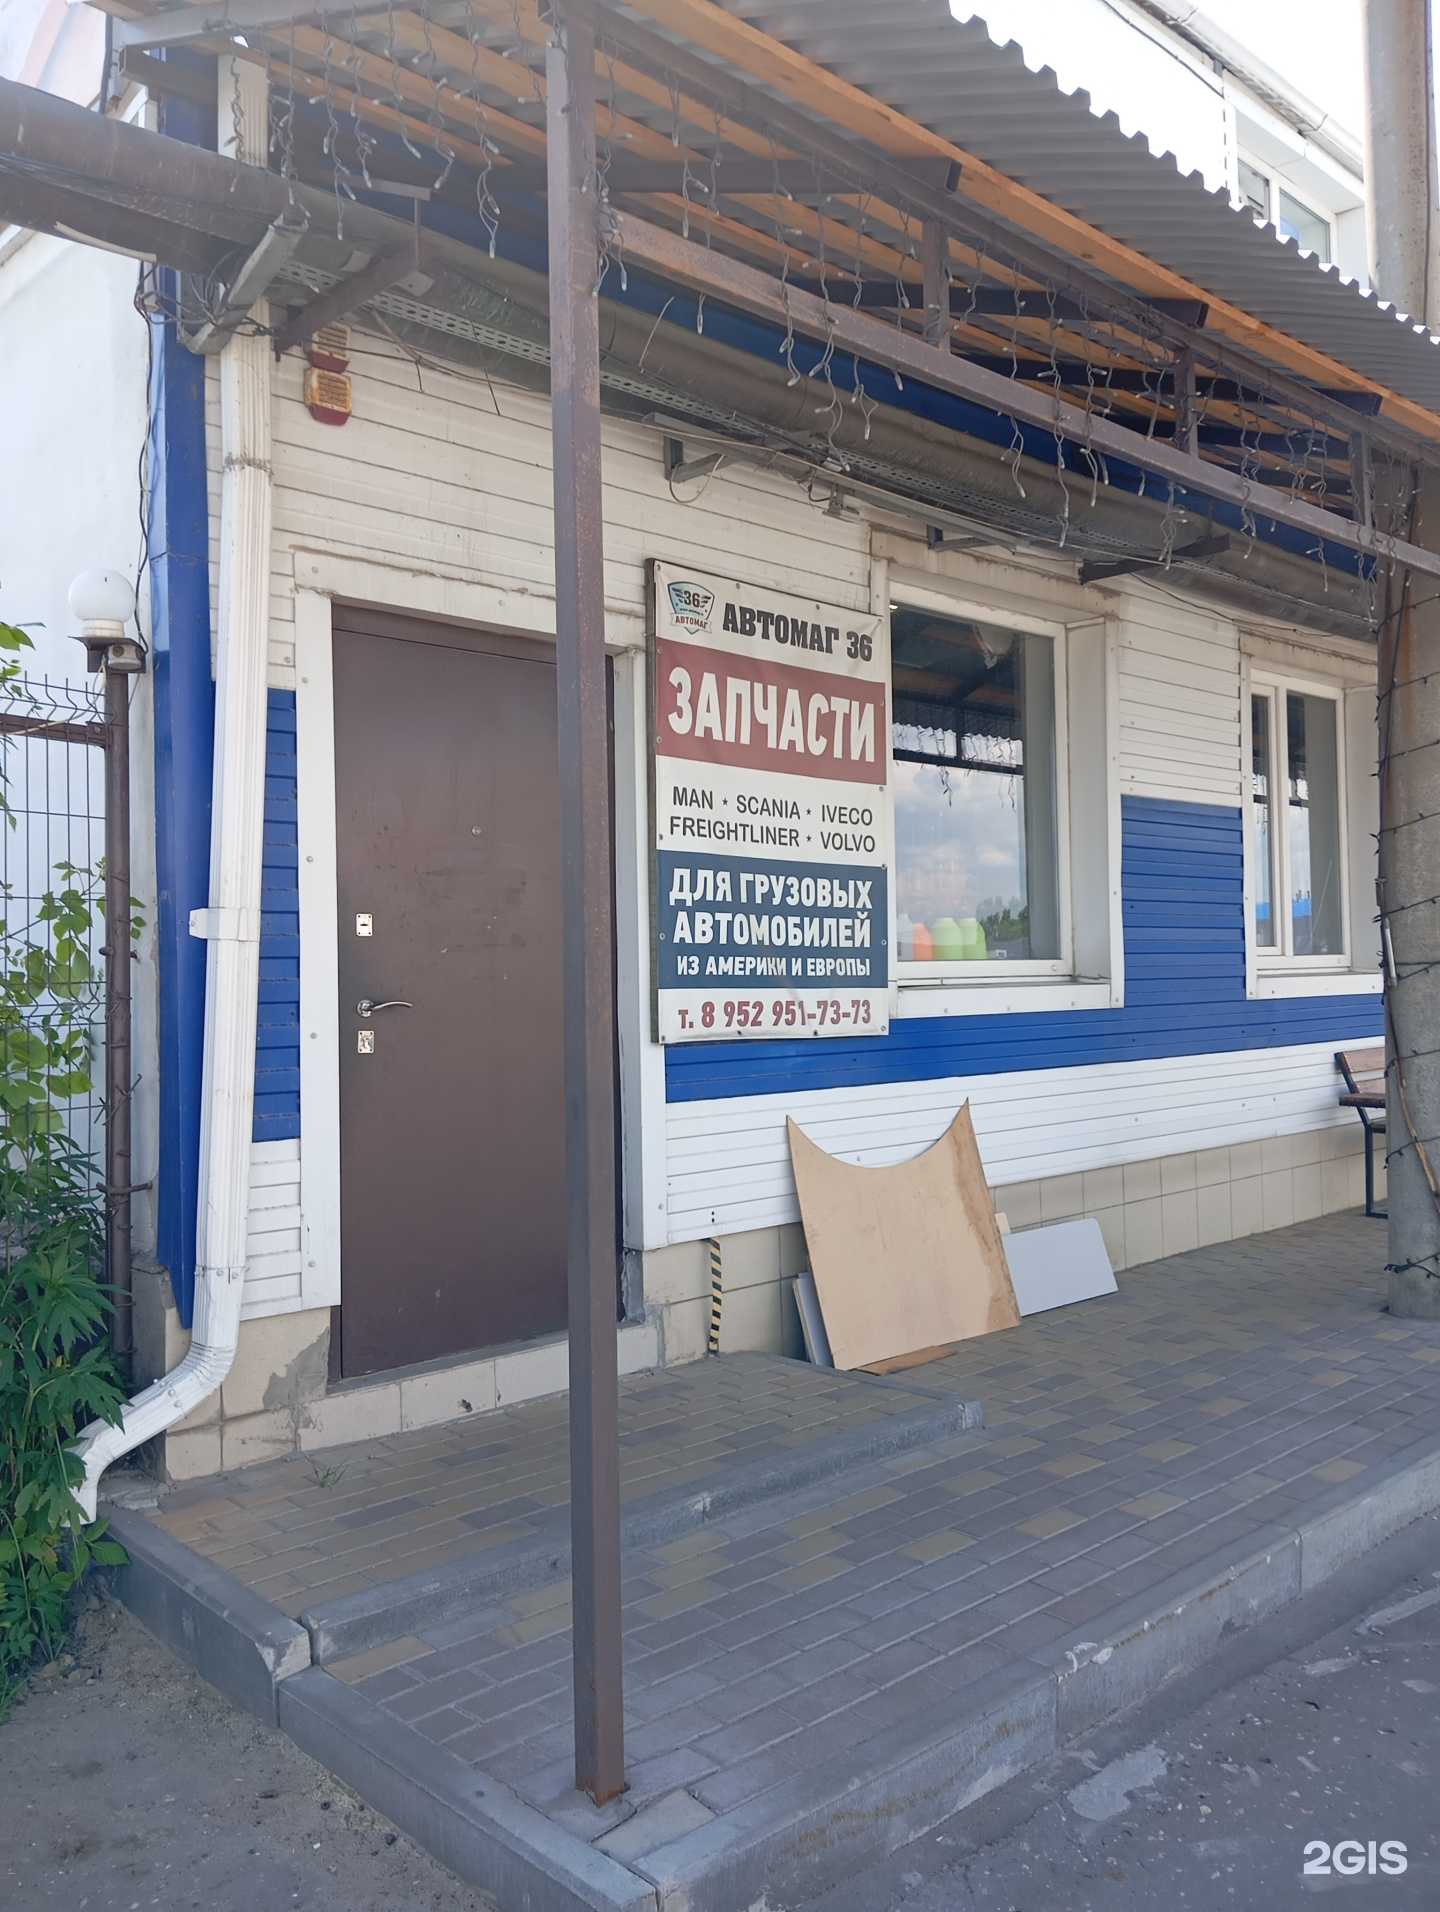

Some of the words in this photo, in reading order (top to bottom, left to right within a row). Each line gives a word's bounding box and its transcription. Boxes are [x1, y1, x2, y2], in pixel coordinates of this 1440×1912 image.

[684, 590, 700, 608] 36
[722, 603, 839, 654] АВТОМАГ
[846, 630, 873, 662] 36
[667, 666, 875, 763] ЗАПЧАСТИ
[673, 786, 713, 810] MAN
[736, 794, 801, 820] SCANIA
[822, 804, 873, 826] IVECO
[670, 816, 800, 847] FREIGHTLINER
[820, 831, 876, 853] VOLVO
[669, 868, 733, 907] ДЛЯ
[740, 872, 873, 909] ГРУЗОВЫХ
[672, 911, 872, 948] АВТОМОБИЛЕЙ
[677, 955, 700, 976] ИЗ
[705, 956, 787, 977] АМЕРИКИ
[791, 957, 802, 976] И
[806, 958, 870, 977] ЕВРОПЫ
[701, 1001, 716, 1028] 8
[724, 1000, 764, 1028] 952
[772, 999, 872, 1026] 951-73-73
